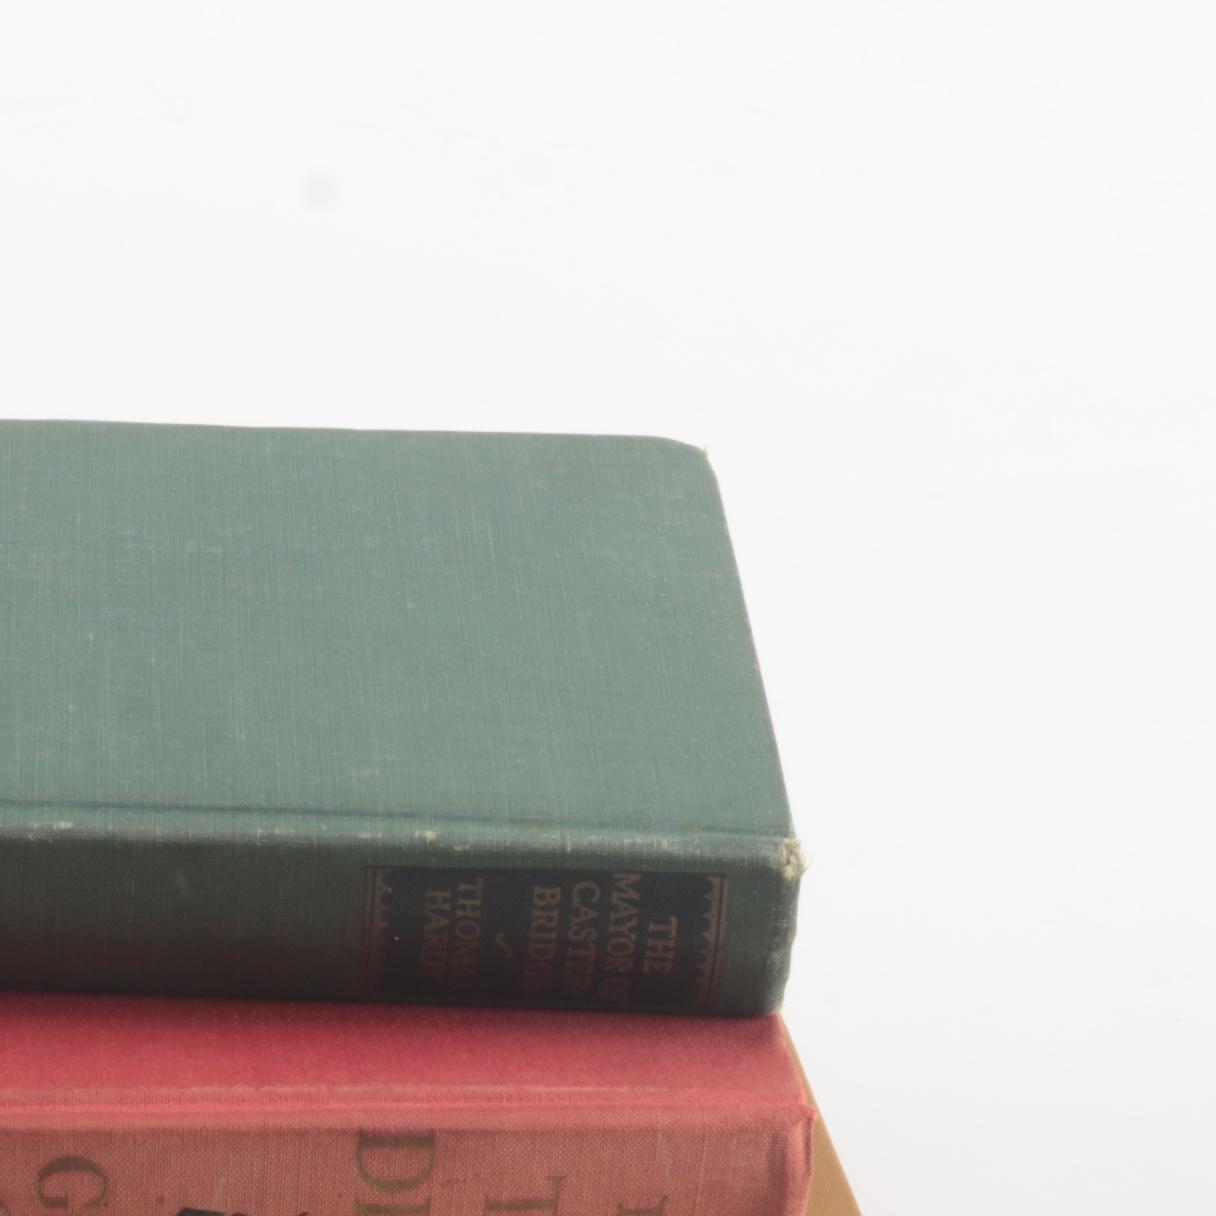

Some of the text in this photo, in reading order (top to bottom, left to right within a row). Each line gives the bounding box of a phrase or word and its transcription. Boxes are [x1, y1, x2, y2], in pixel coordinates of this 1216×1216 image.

[521, 884, 561, 991] BRIDGE
[604, 873, 642, 972] MAYOR
[642, 915, 678, 976] THE
